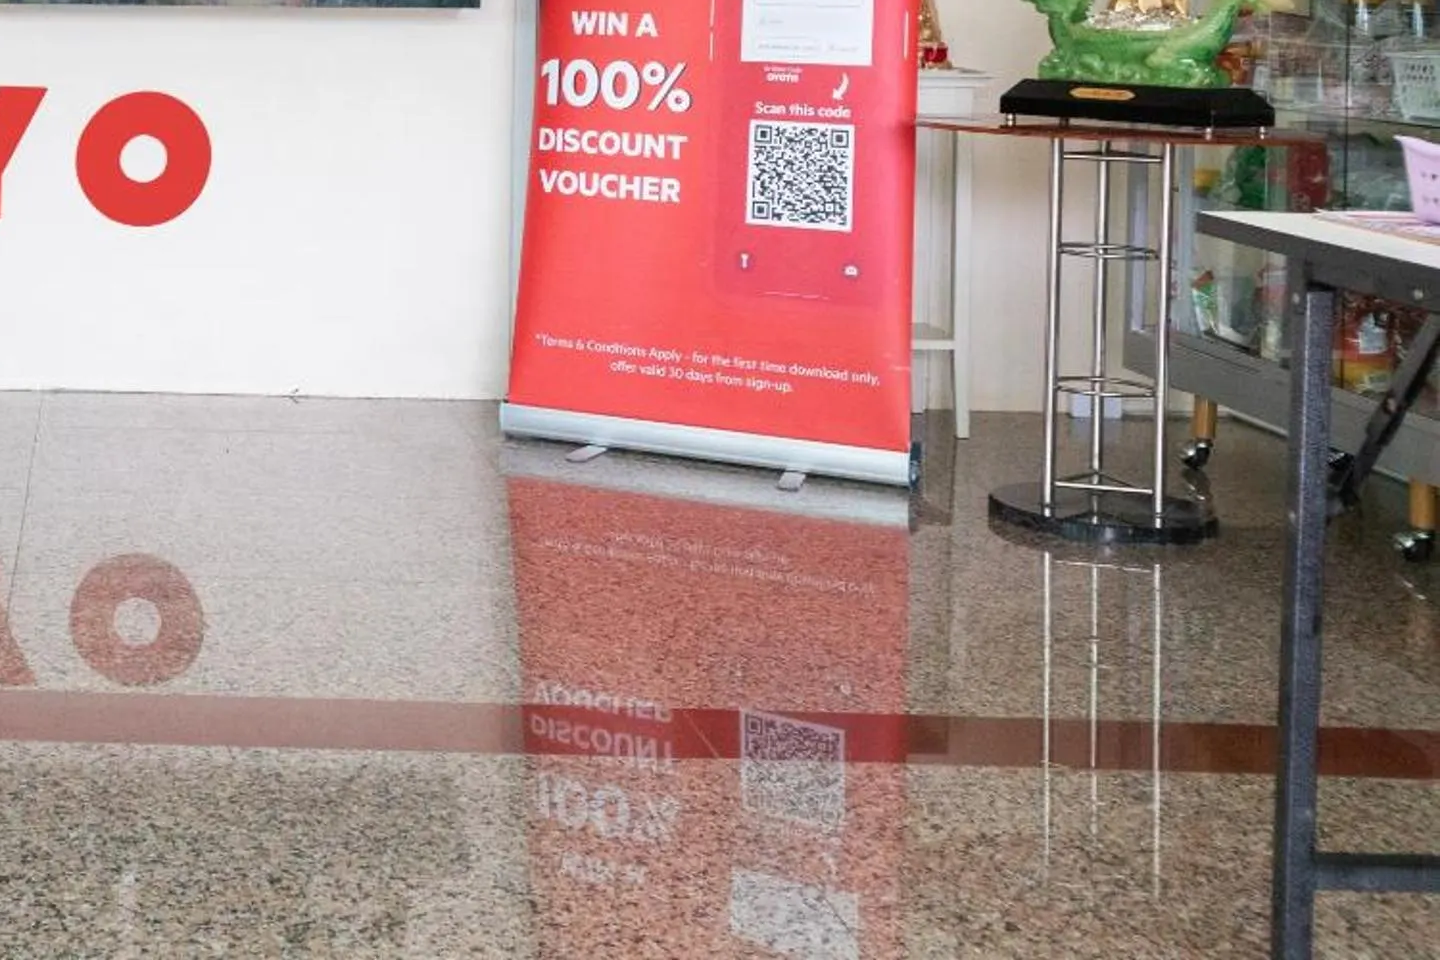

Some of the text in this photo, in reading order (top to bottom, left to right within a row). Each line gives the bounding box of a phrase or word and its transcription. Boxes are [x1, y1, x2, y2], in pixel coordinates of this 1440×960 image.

[572, 11, 658, 37] WIN A
[541, 57, 692, 113] 100%
[755, 100, 852, 118] Scan this code
[539, 127, 688, 159] DISCOUNT
[539, 168, 681, 203] VOUCHER
[587, 341, 647, 358] Conditions
[649, 347, 682, 364] Apply
[692, 351, 708, 365] for
[711, 354, 731, 368] the
[733, 356, 757, 370] first
[760, 359, 787, 374] time
[789, 363, 848, 382] download
[610, 360, 637, 373] offer
[640, 364, 666, 377] valid
[669, 368, 684, 380] 30
[685, 369, 714, 383] days
[716, 372, 743, 387] from
